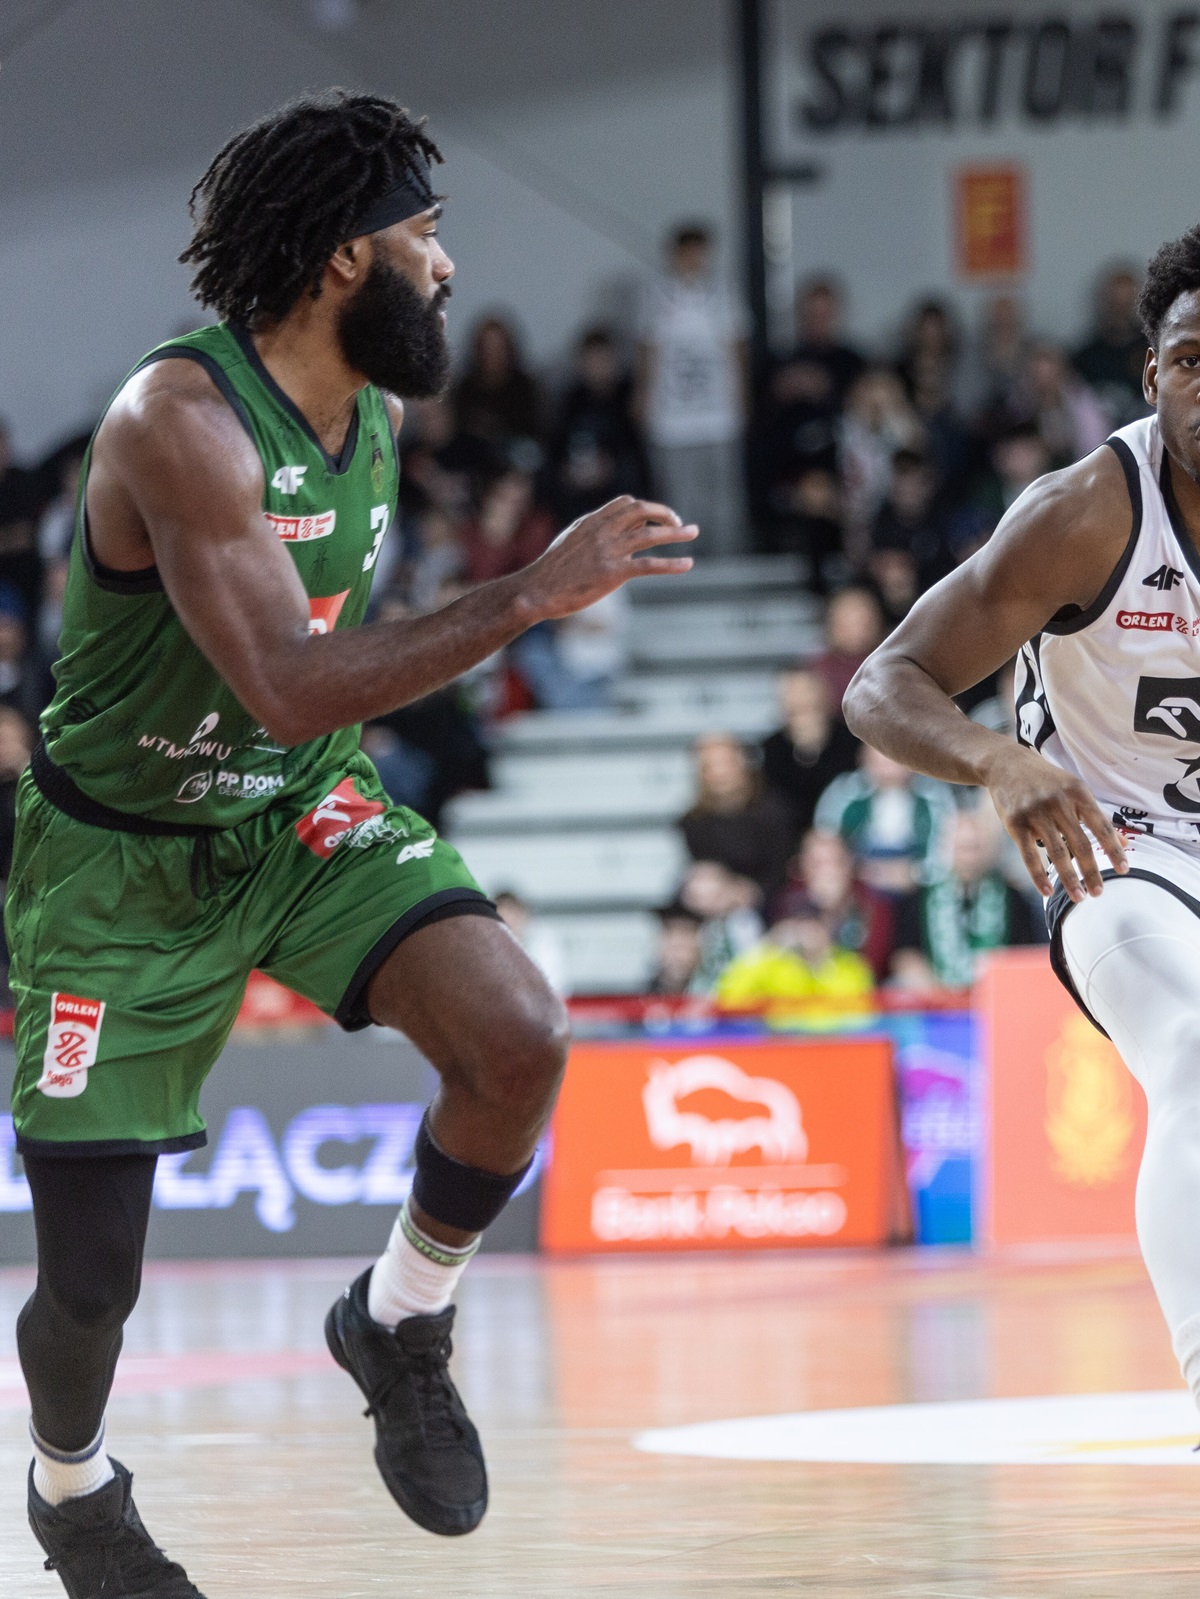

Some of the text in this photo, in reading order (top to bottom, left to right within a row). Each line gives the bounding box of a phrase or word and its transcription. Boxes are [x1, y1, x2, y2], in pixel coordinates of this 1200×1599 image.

[800, 18, 1136, 134] SEKTOR
[271, 466, 308, 495] 4F
[1142, 565, 1184, 591] 4F
[1121, 615, 1168, 627] ORLEN
[216, 771, 240, 787] PP
[243, 774, 285, 790] DOM
[218, 786, 277, 799] DEWELOPER
[396, 838, 435, 865] 4F
[57, 1002, 98, 1017] ORLEN
